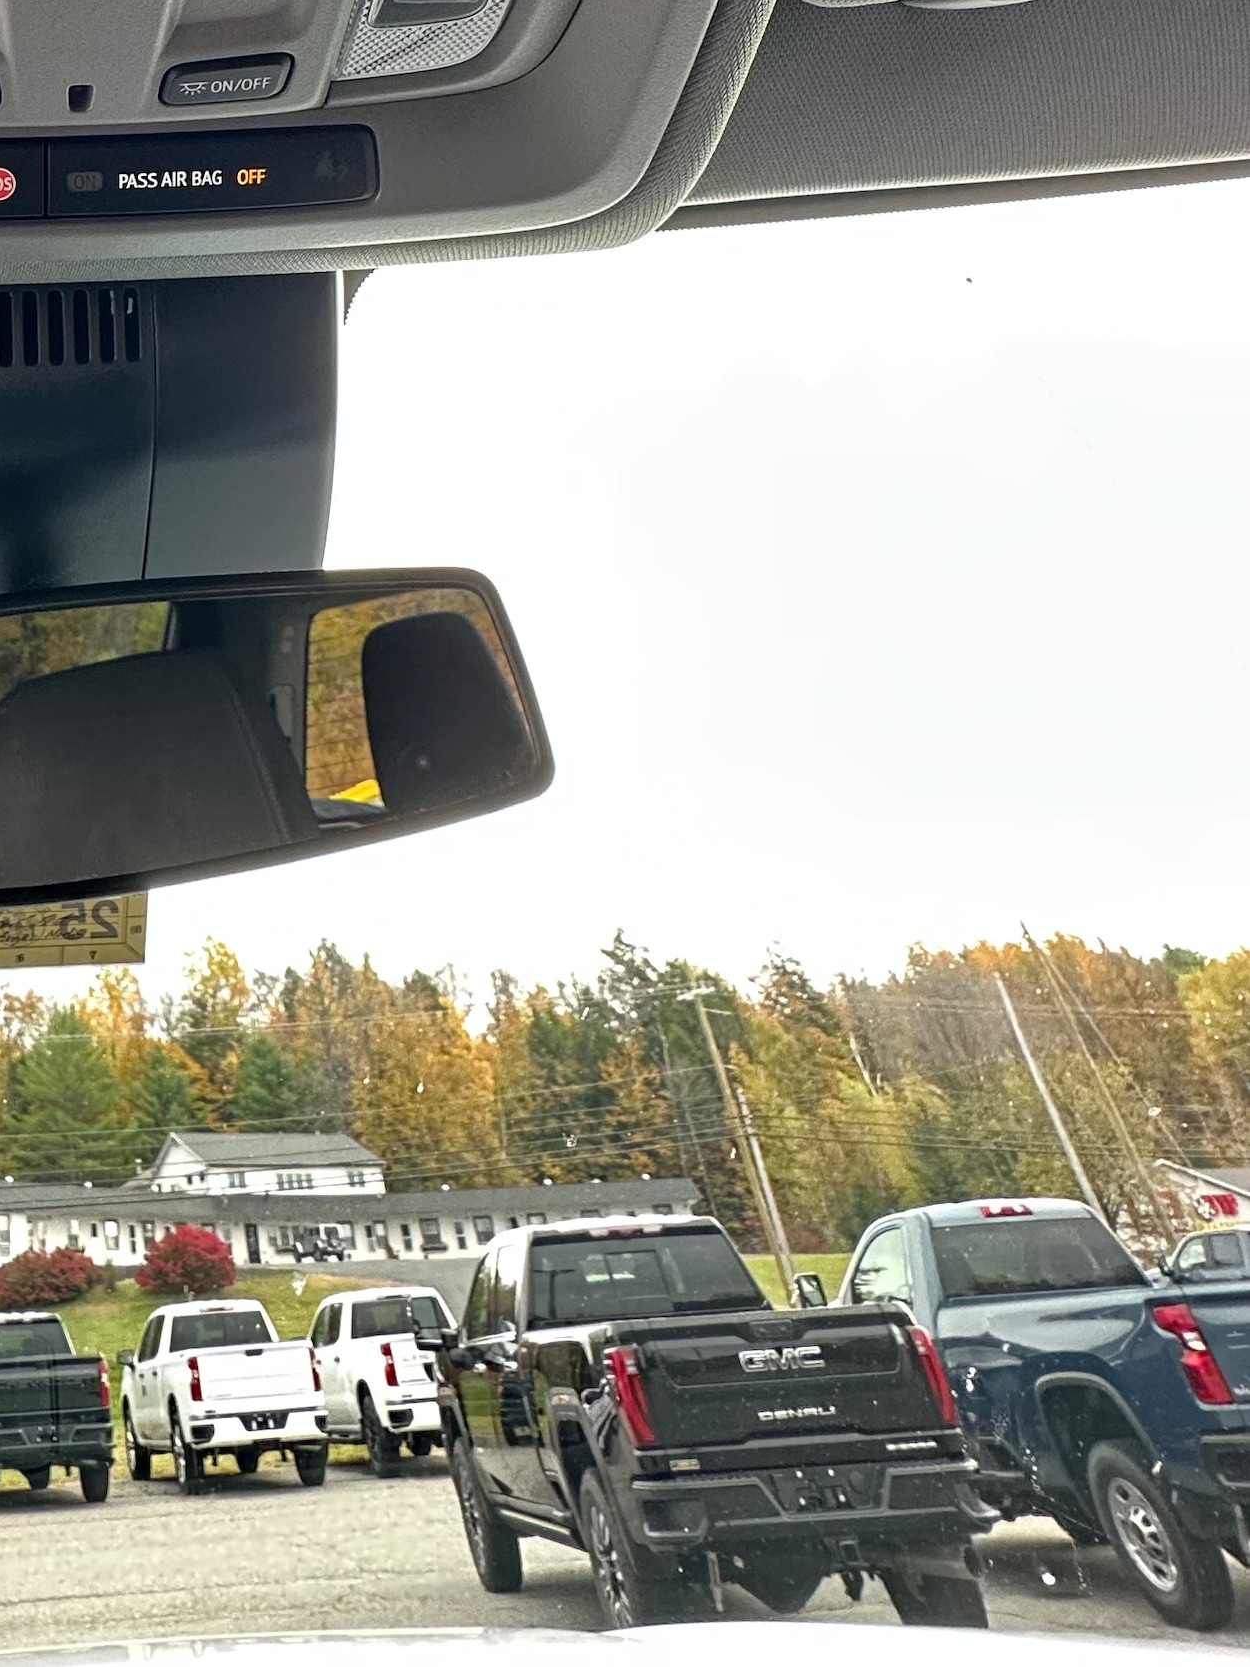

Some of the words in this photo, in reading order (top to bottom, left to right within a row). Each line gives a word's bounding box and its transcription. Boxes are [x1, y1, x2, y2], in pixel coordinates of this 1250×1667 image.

[210, 76, 272, 93] ON/OFF
[73, 174, 97, 190] ON
[118, 172, 158, 189] PASS
[160, 171, 188, 188] AIR
[191, 170, 223, 186] BAG
[237, 168, 267, 185] OFF
[738, 1345, 826, 1373] GMC
[758, 1405, 837, 1422] DENALI
